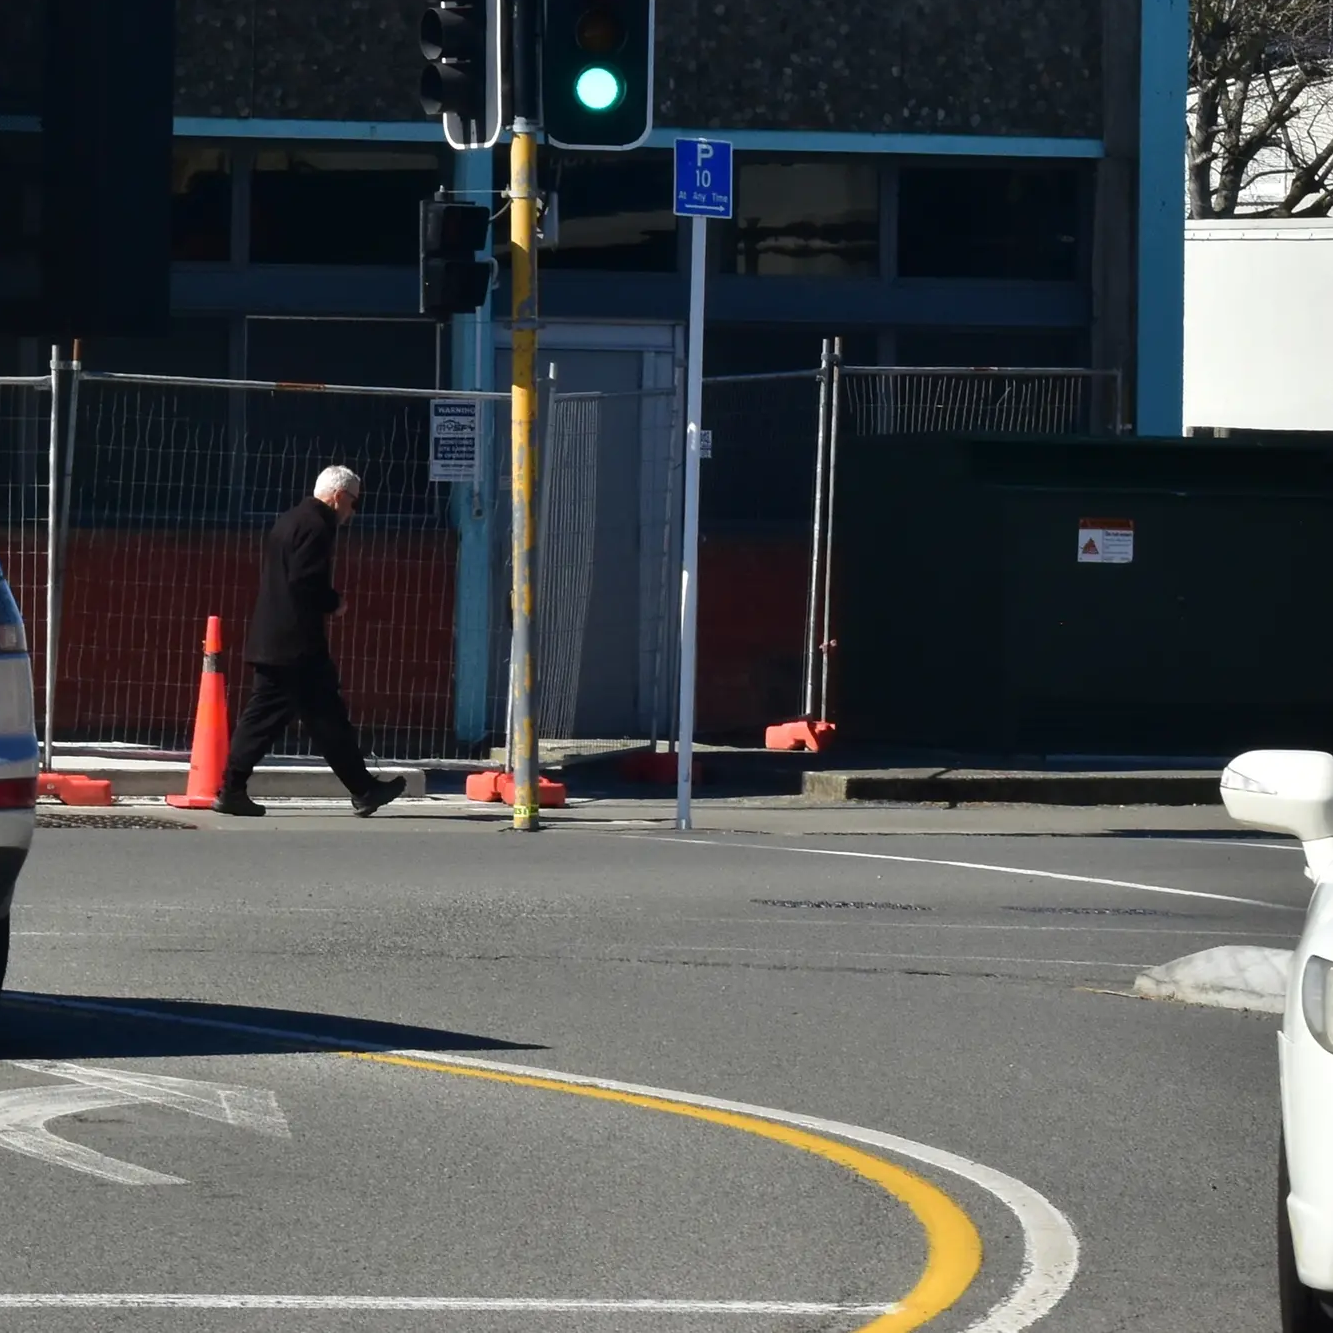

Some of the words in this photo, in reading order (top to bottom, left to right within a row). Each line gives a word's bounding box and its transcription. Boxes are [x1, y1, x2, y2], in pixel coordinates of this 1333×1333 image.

[697, 143, 714, 167] P
[696, 169, 711, 188] 10
[678, 190, 687, 200] At
[693, 191, 707, 203] Any
[712, 192, 728, 204] Time
